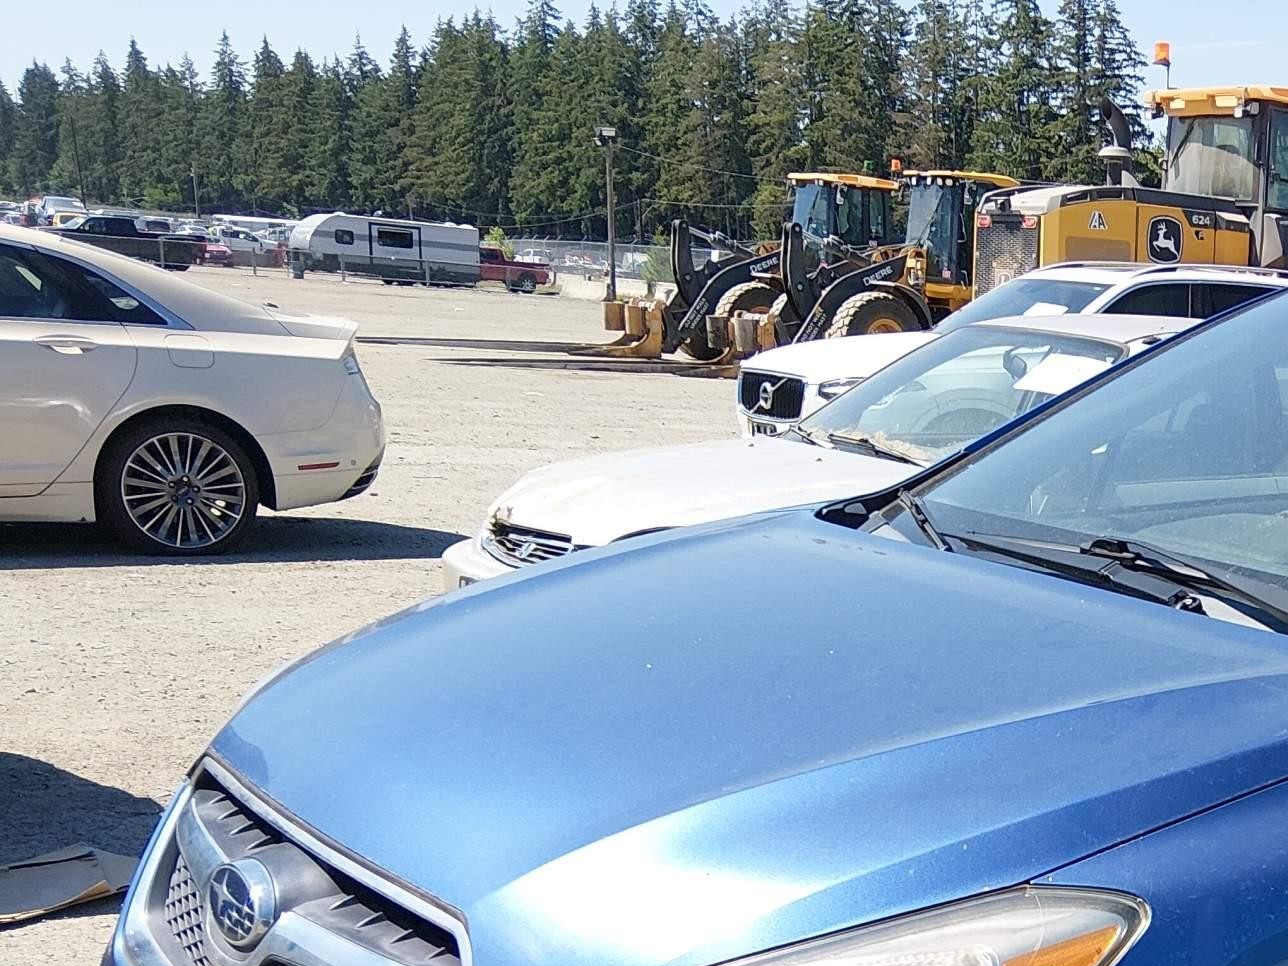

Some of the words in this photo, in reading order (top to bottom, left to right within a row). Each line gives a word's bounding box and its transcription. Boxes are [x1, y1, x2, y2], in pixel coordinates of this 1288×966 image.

[1192, 214, 1210, 227] 624
[750, 256, 779, 274] DEERE
[862, 266, 894, 286] DEERE
[689, 310, 697, 321] NOT
[805, 322, 815, 335] NOT
